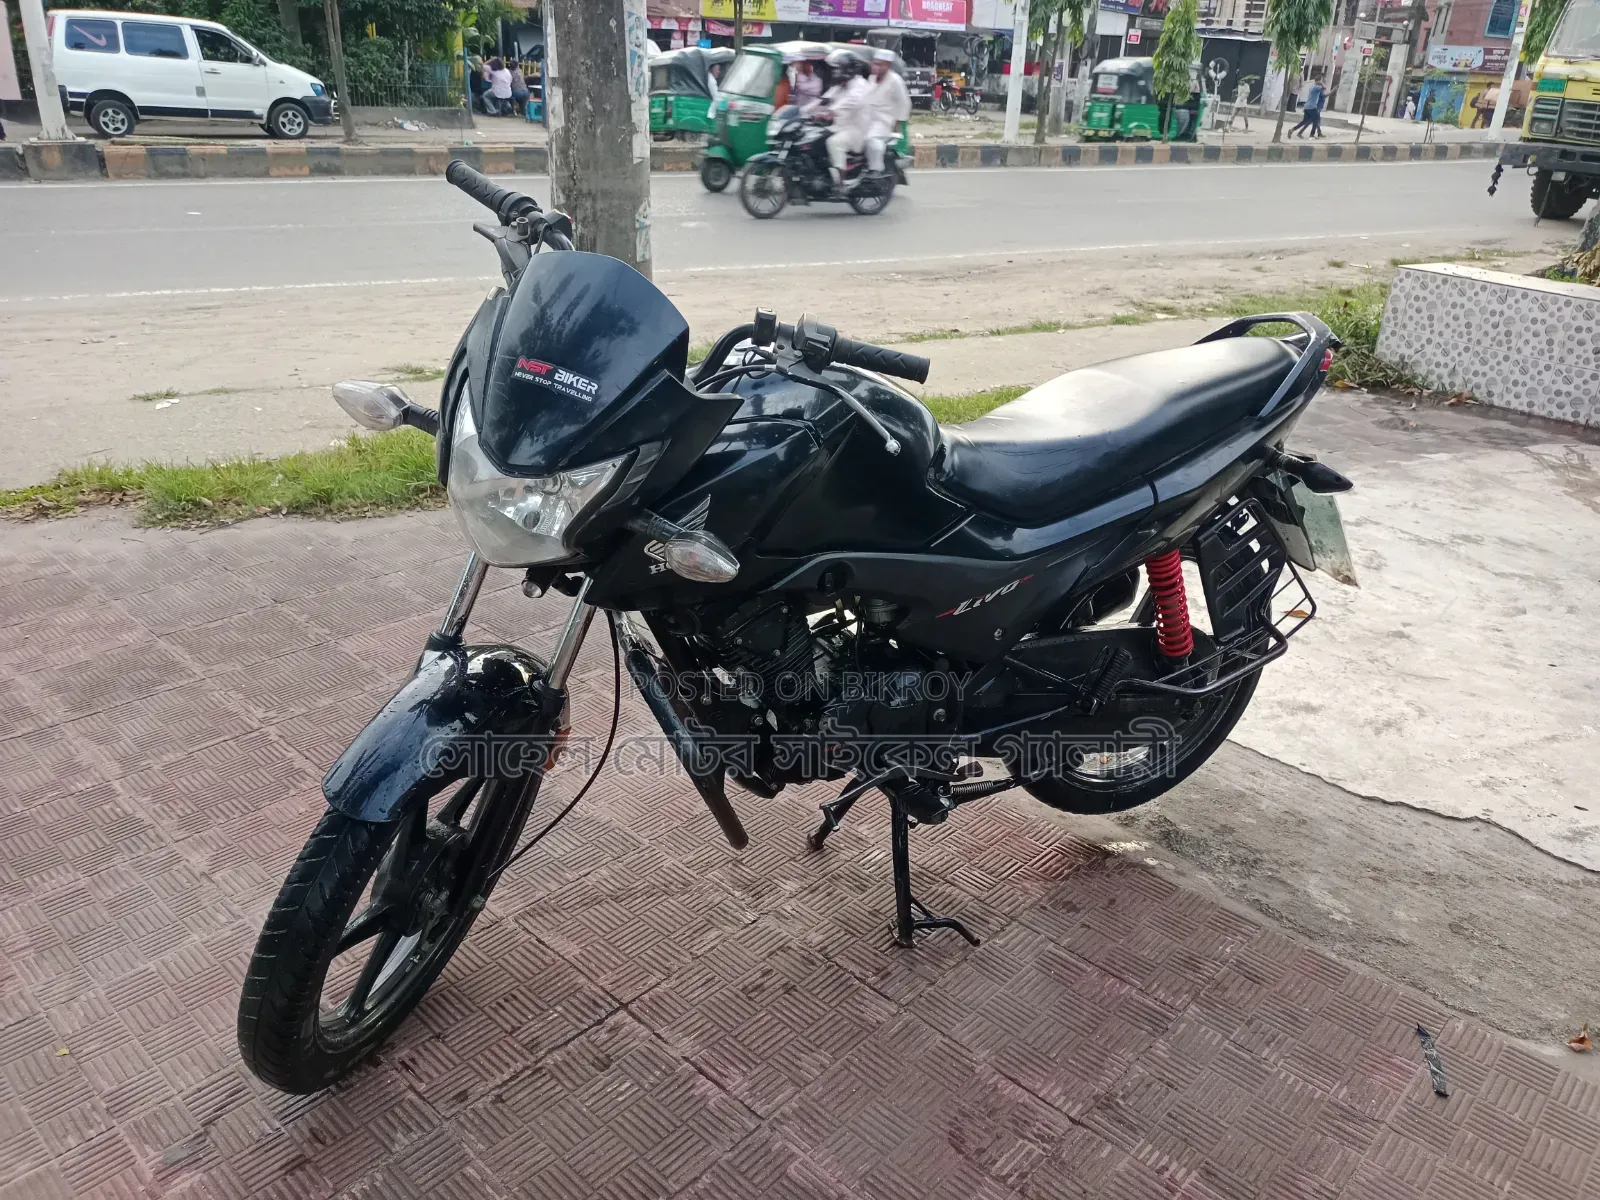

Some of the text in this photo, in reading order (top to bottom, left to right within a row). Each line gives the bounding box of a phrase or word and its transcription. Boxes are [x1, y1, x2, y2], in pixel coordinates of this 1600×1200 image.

[514, 371, 593, 402] NEVER STOP TRAVELLING
[517, 357, 599, 395] NST BIKER
